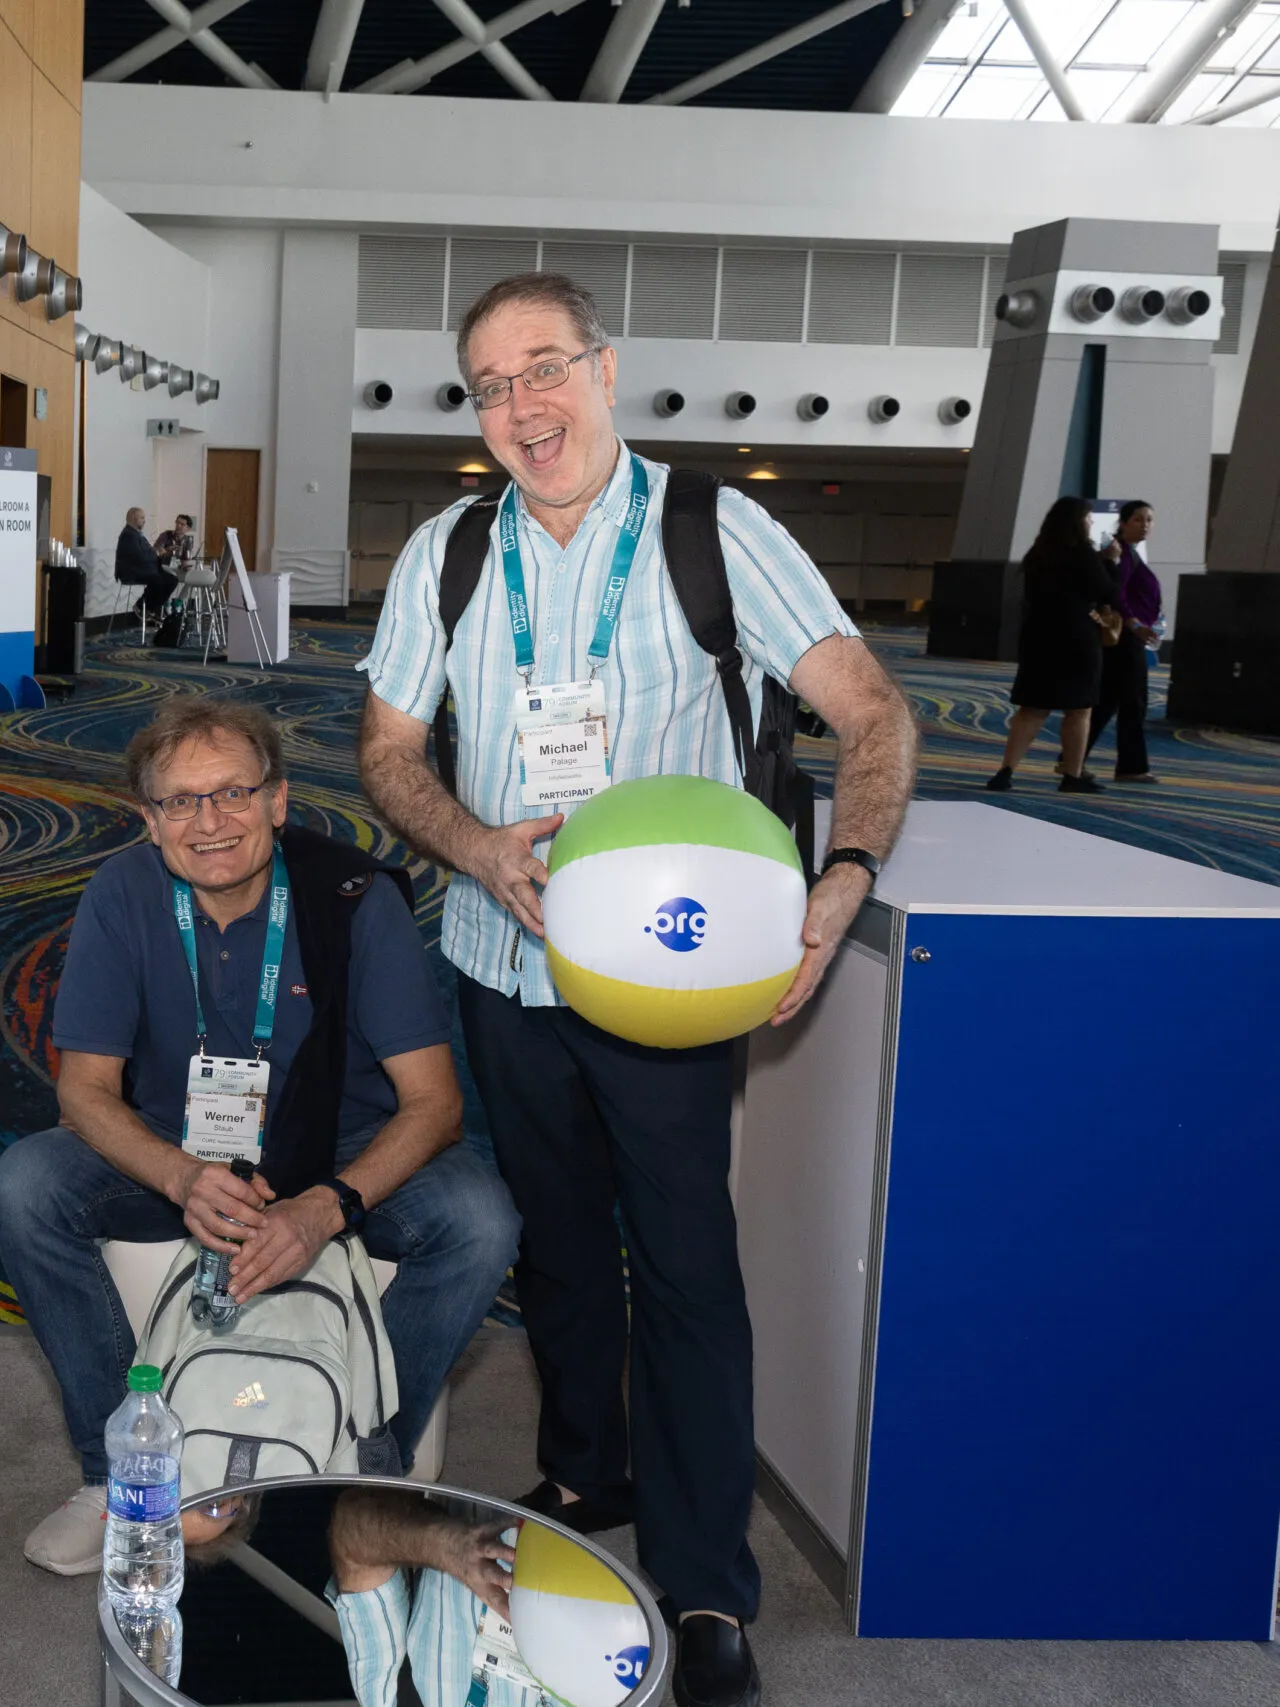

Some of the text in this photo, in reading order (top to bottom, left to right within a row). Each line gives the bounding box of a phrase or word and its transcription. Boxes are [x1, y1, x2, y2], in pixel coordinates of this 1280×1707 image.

[25, 502, 30, 512] A
[6, 519, 31, 531] ROOM
[507, 513, 515, 536] digital
[625, 506, 637, 532] digital
[630, 509, 645, 538] identity
[510, 590, 519, 620] identity
[516, 593, 526, 618] digital
[603, 591, 613, 616] digital
[607, 591, 621, 621] identity
[540, 740, 588, 756] Michael
[551, 758, 577, 766] Palage
[539, 788, 594, 800] PARTICIPANT
[182, 893, 190, 916] digital
[277, 900, 287, 928] identity
[644, 912, 707, 944] .org
[261, 977, 269, 1000] digital
[266, 978, 277, 1006] identity
[205, 1111, 246, 1123] Werner
[214, 1124, 234, 1132] Staub
[197, 1150, 245, 1160] PARTICIPANT
